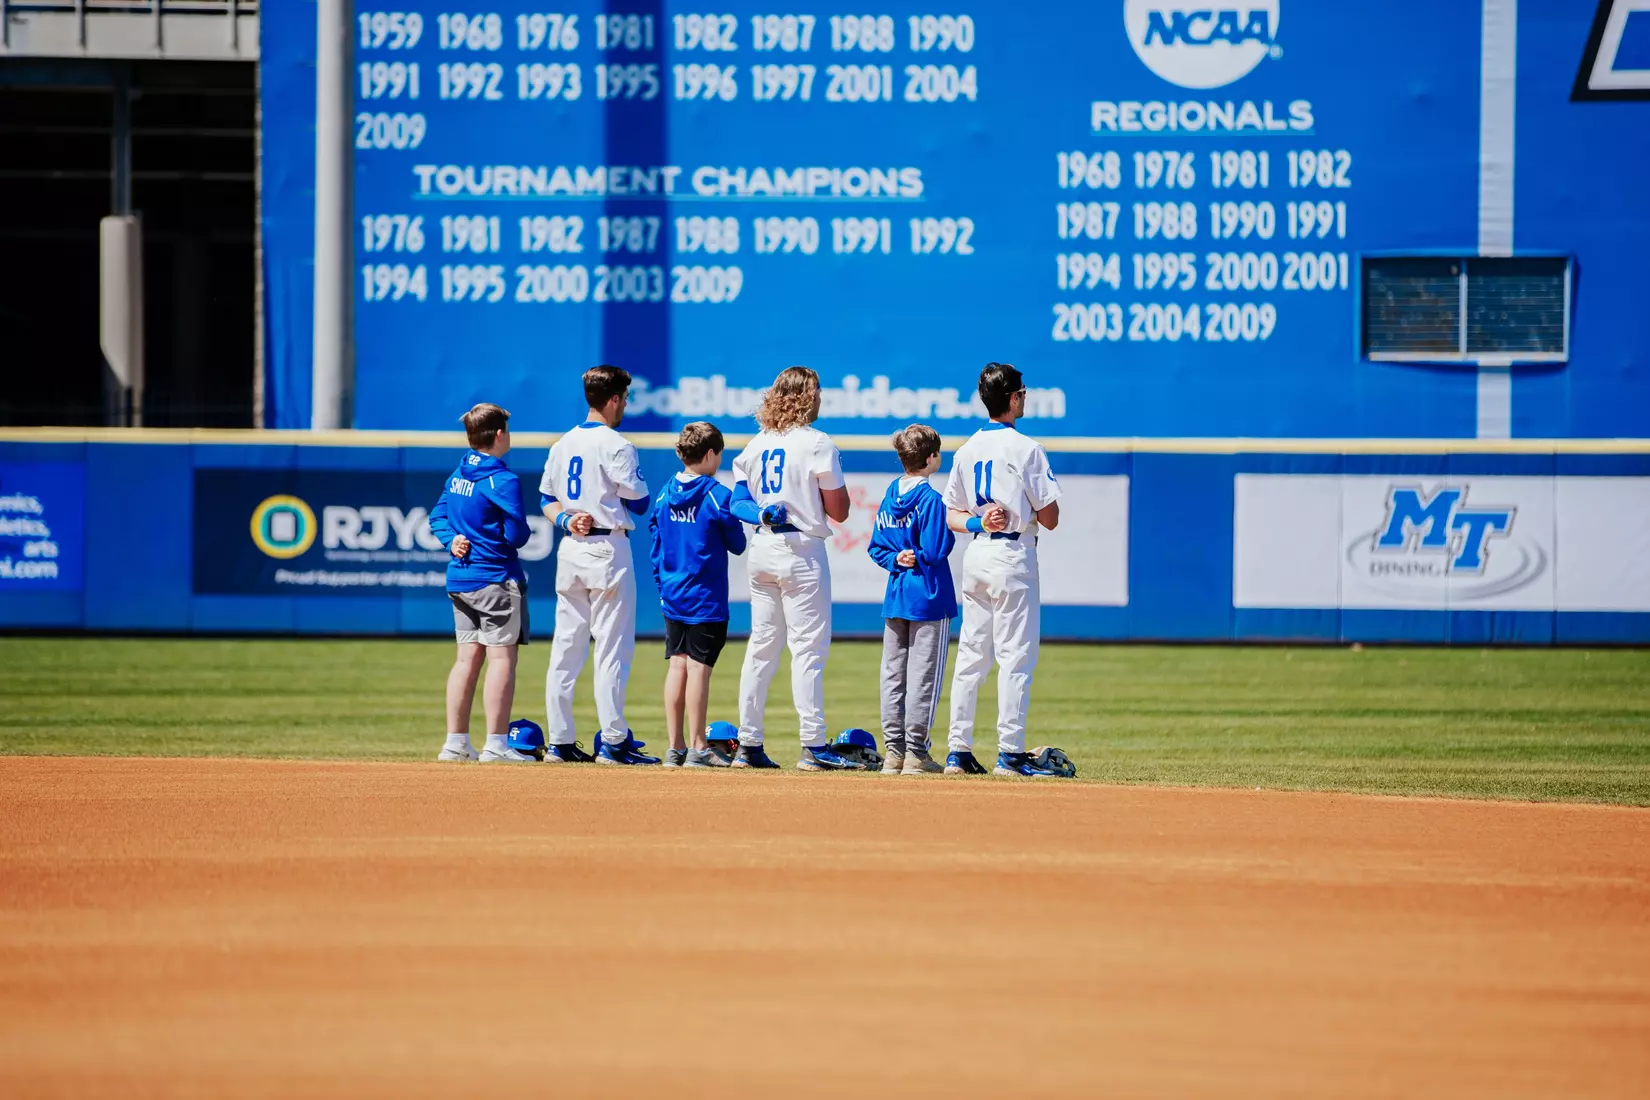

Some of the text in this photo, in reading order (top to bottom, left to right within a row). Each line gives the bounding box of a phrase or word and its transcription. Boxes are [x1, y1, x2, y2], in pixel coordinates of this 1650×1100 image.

[358, 11, 975, 53] 1959 1968 1976 1981 1982 1987 1988 1990
[1143, 9, 1273, 46] NCAA
[359, 61, 977, 103] 1991 1992 1993 1995 1996 1997 2001 2004
[355, 112, 426, 150] 2009
[1091, 99, 1314, 131] REGIONALS
[413, 164, 924, 198] TOURNAMENT CHAMPIONS
[1057, 149, 1352, 190] 1968 1976 1981 1982
[362, 214, 975, 256] 1976 1981 1982 1987 1988 1990 1991 1992
[1056, 200, 1347, 240] 1987 1988 1990 1991
[362, 263, 744, 304] 1994 1995 2000 2003 2009
[1056, 251, 1348, 291] 1994 1995 2000 2001
[1051, 302, 1277, 342] 2003 2004 2009
[450, 477, 475, 497] SMITH
[567, 455, 583, 501] 8
[761, 448, 786, 494] 13
[973, 459, 997, 507] 11
